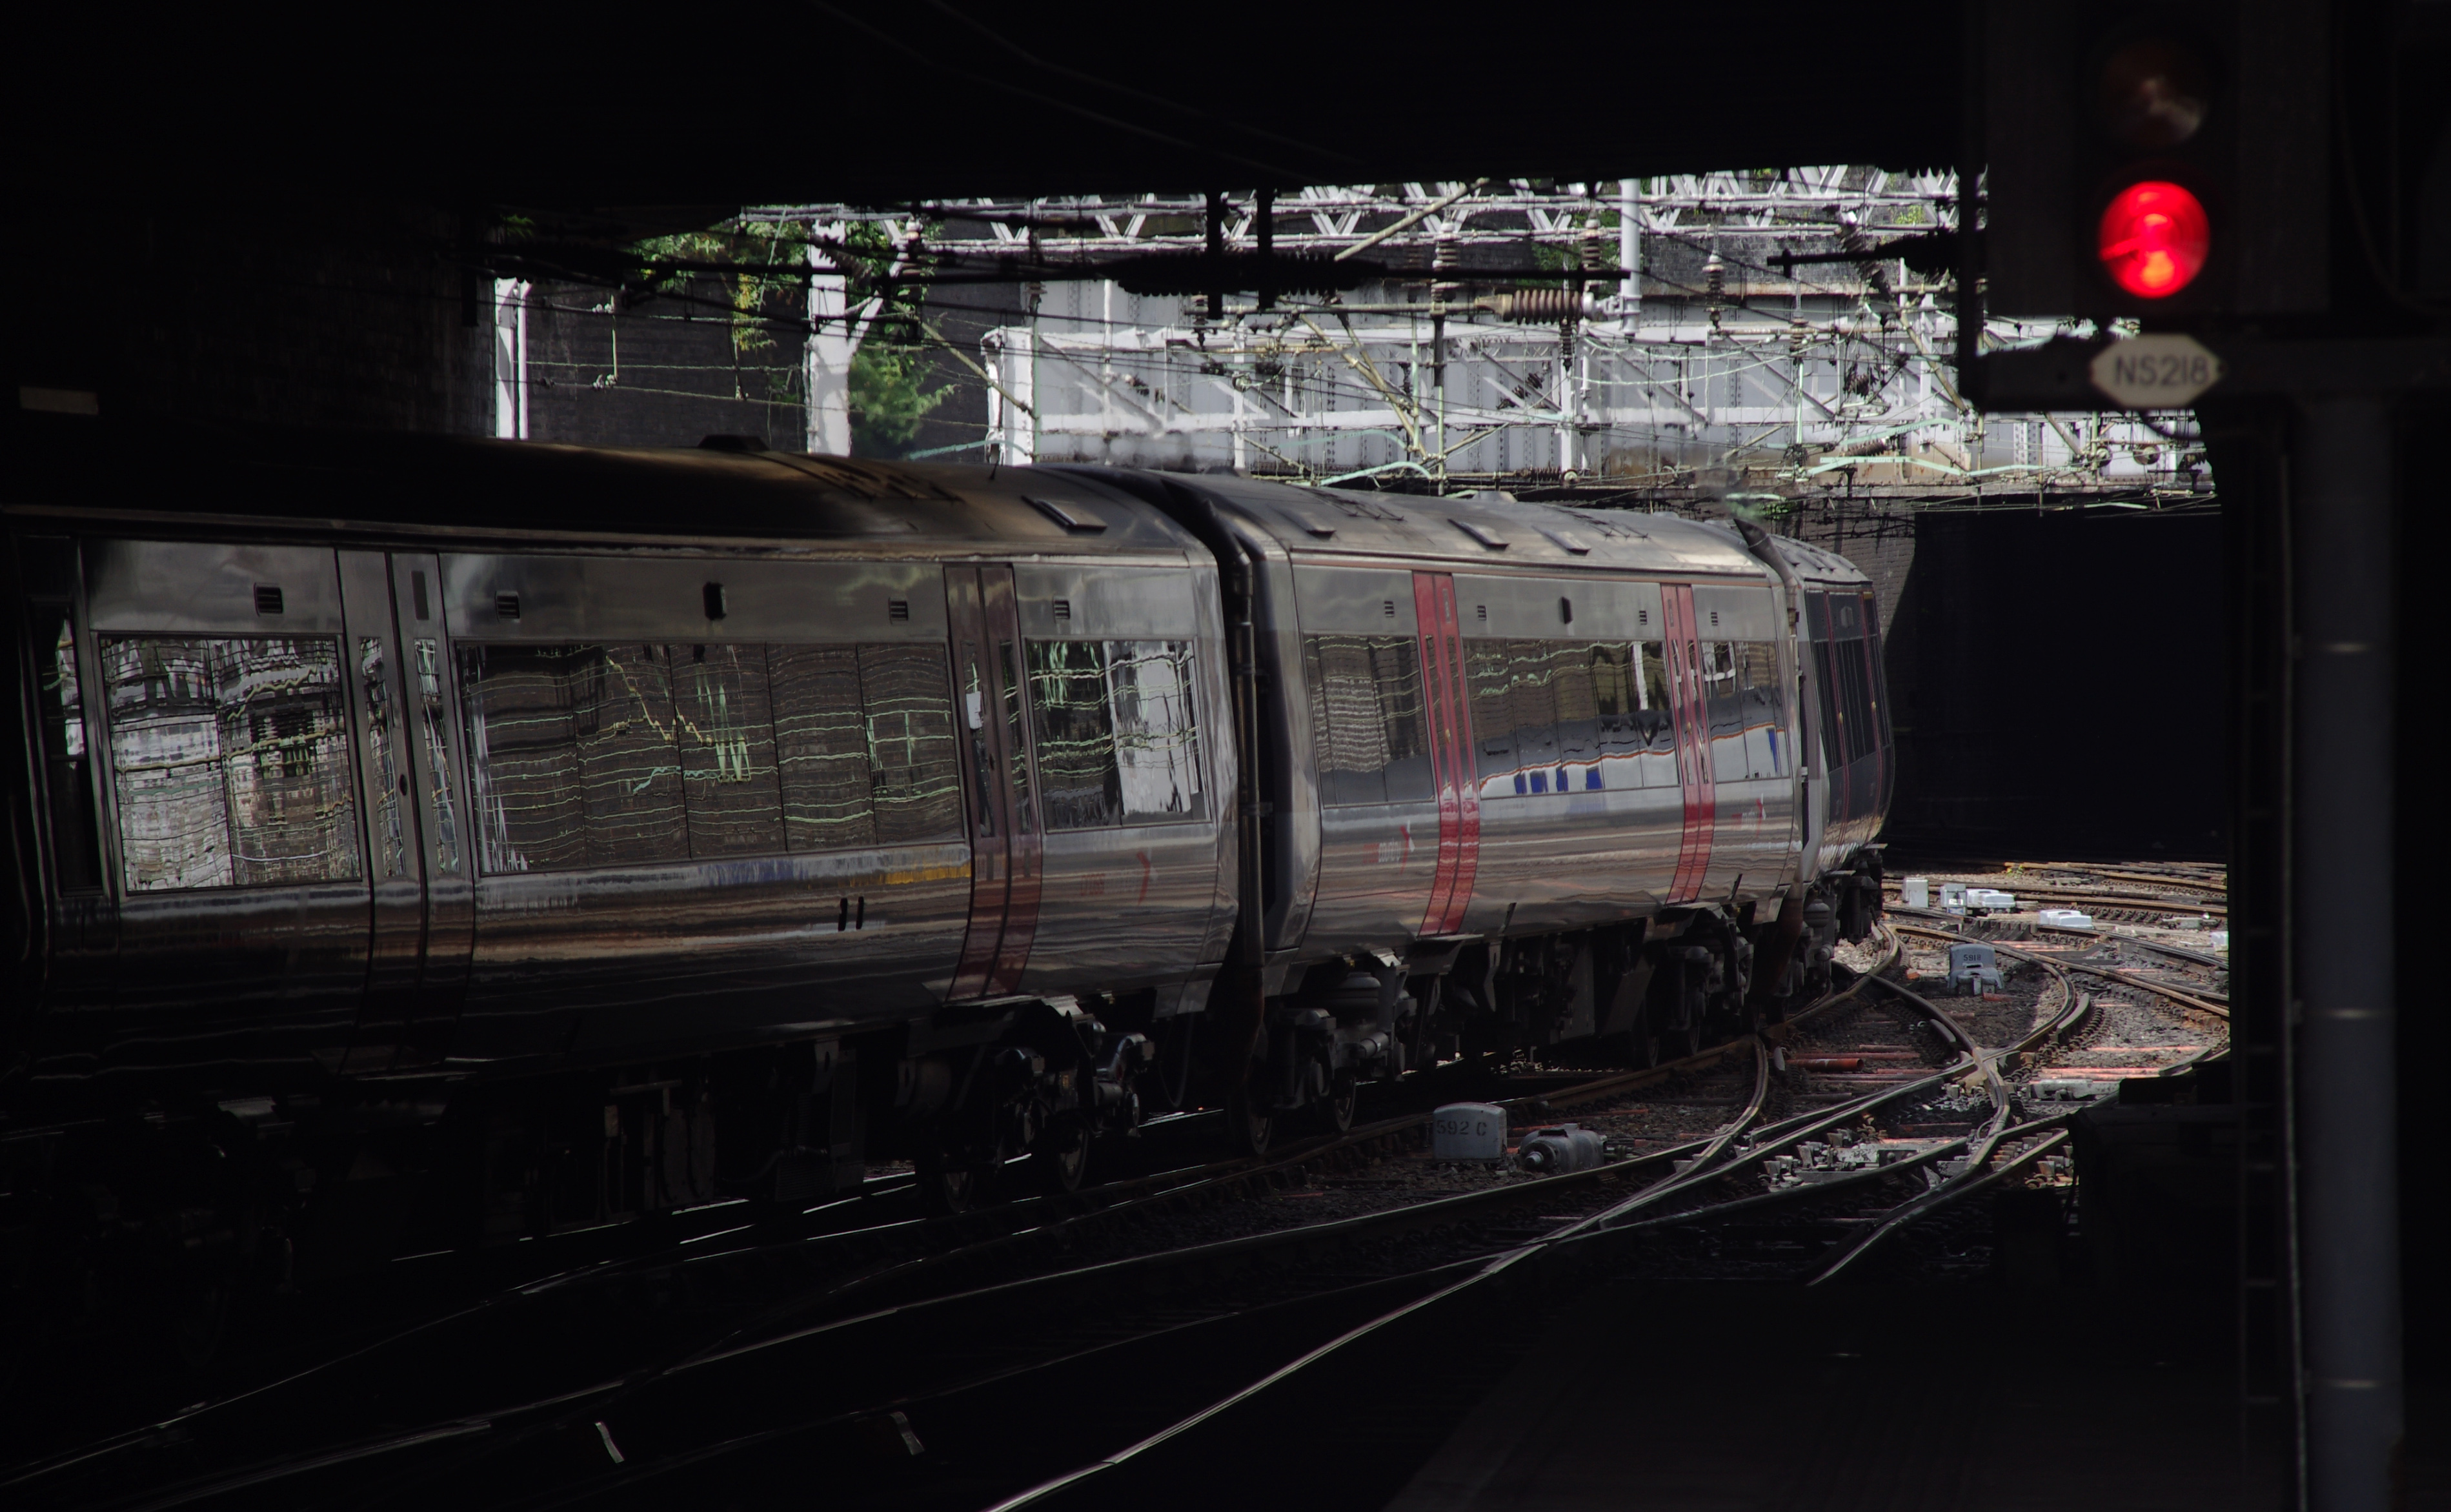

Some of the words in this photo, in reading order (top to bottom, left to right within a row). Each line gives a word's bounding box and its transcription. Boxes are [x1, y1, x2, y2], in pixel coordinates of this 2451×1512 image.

[2115, 355, 2208, 385] NS218
[1436, 1120, 1469, 1135] 592
[1476, 1122, 1488, 1136] C
